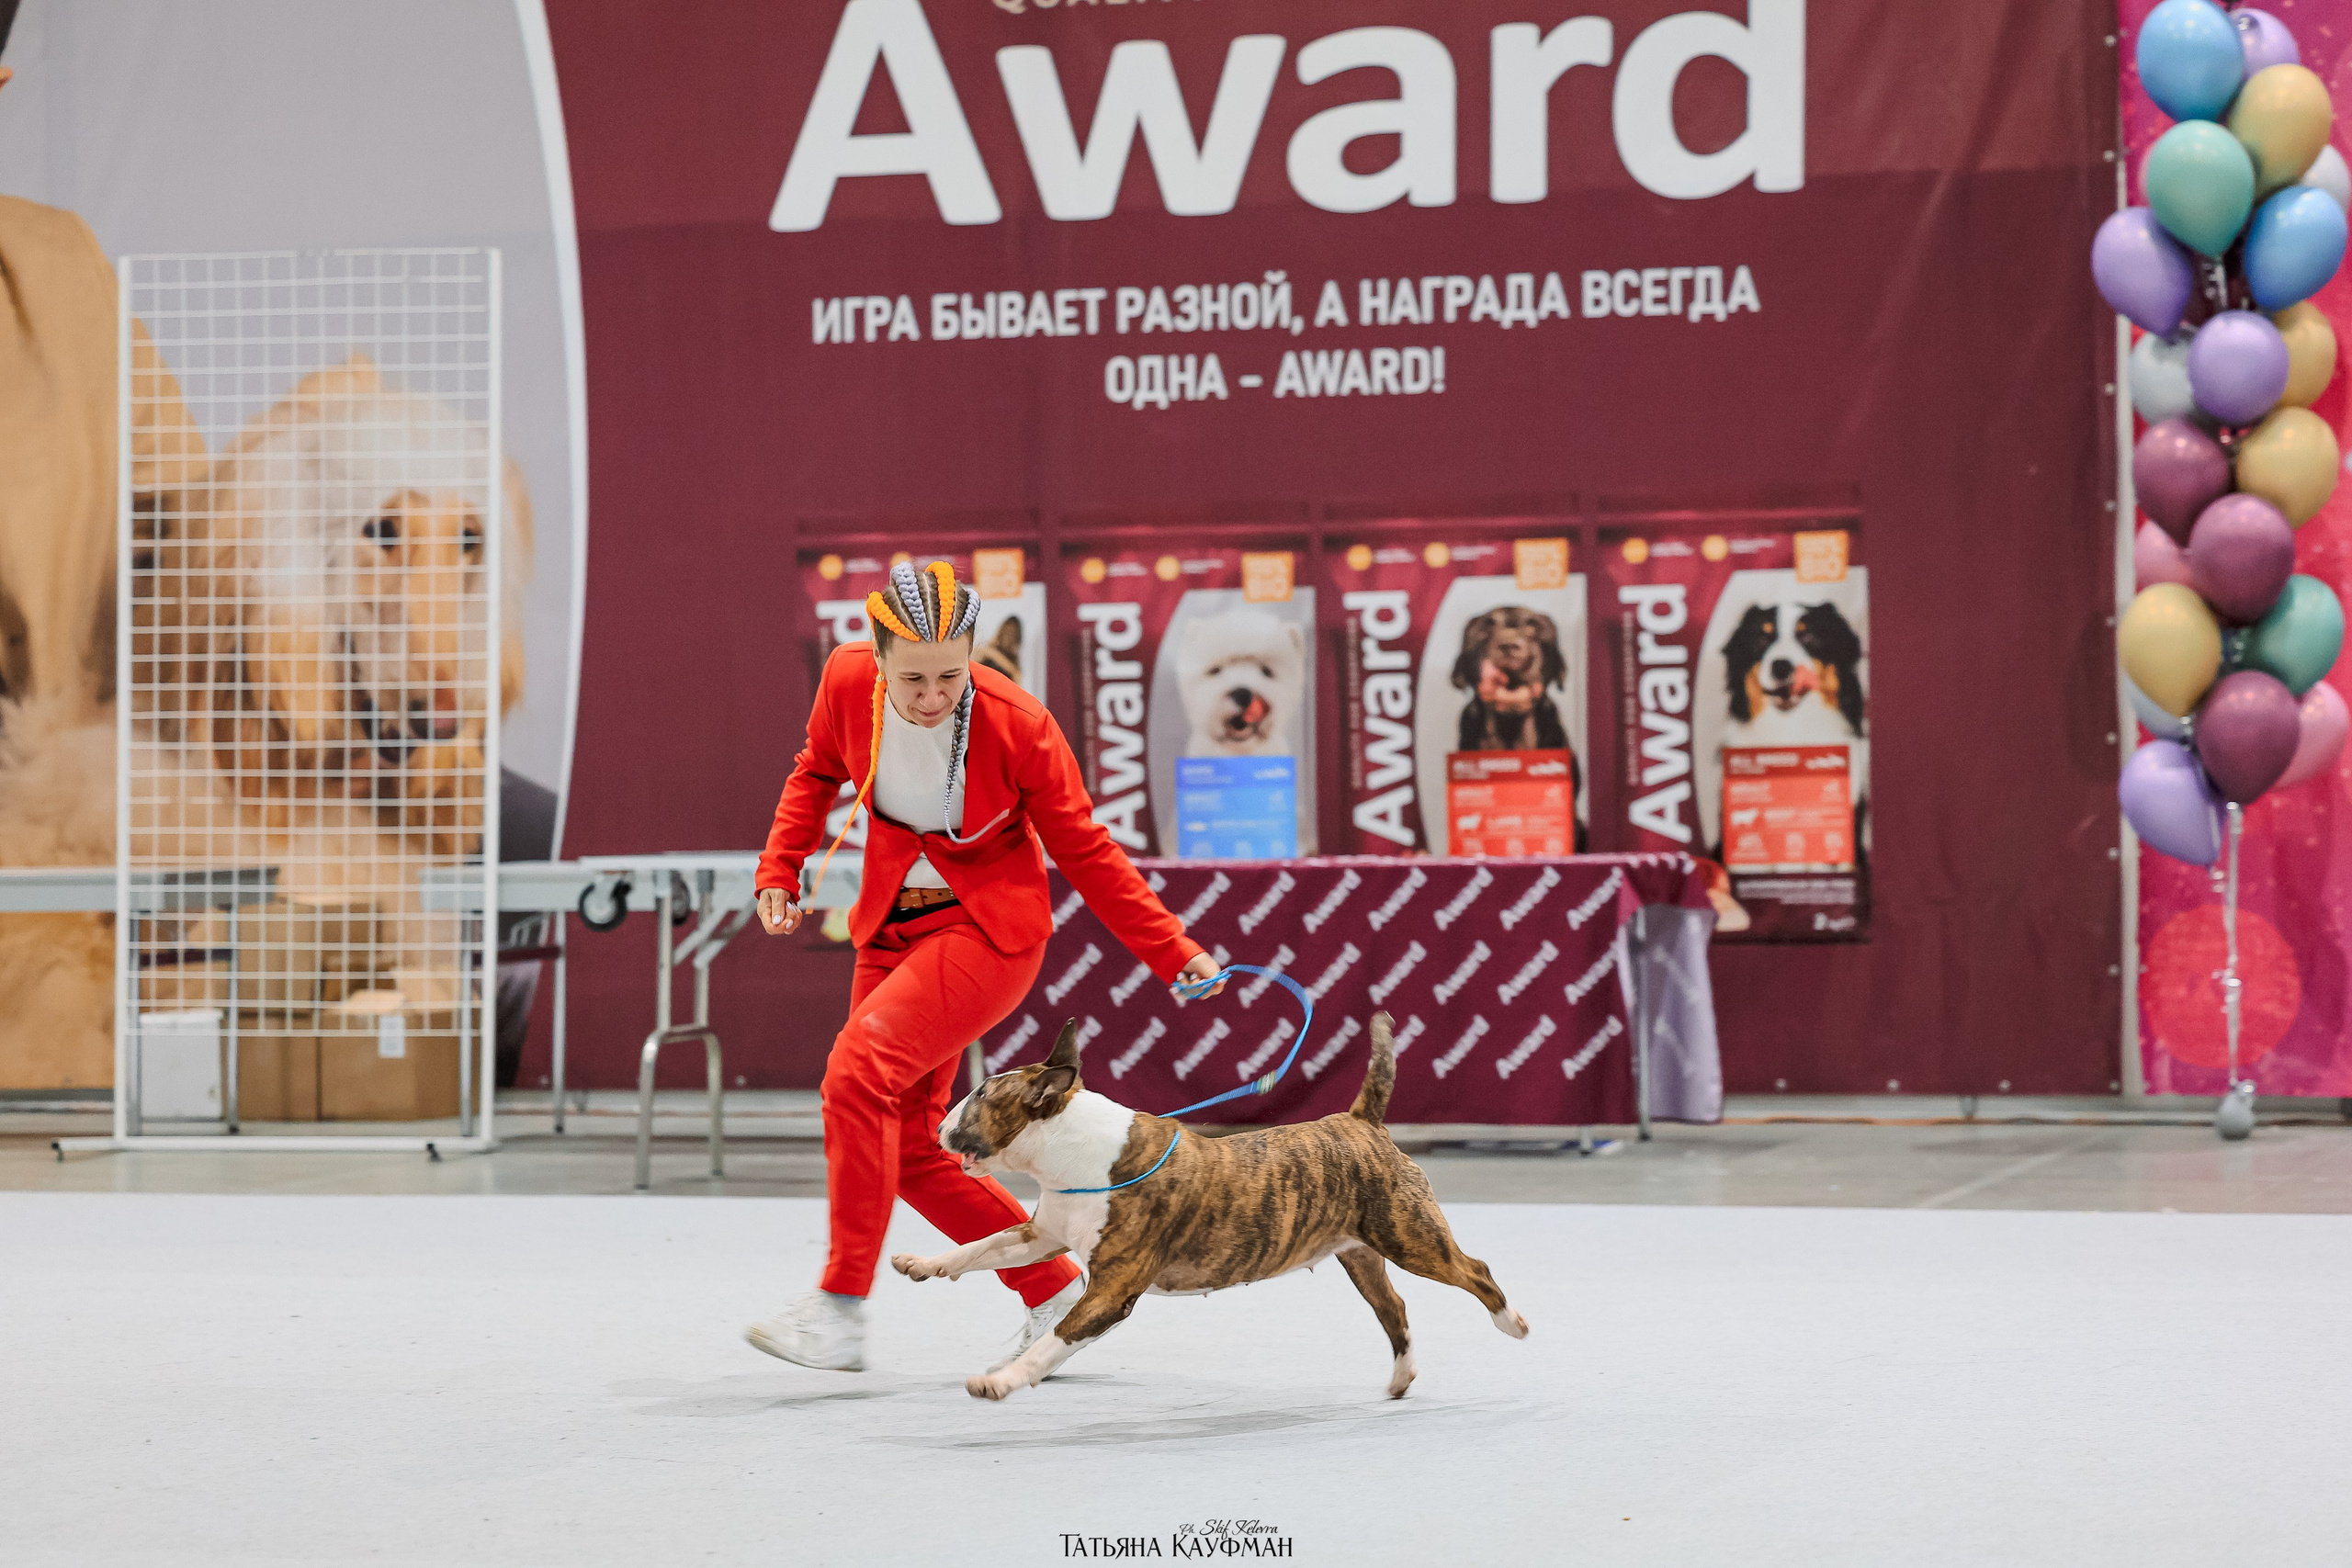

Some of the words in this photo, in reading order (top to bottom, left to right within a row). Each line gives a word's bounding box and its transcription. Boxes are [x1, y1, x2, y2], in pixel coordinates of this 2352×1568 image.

[769, 0, 1807, 232] Award
[811, 296, 921, 345] ИГРА
[931, 287, 1108, 342] БЫВАЕТ
[1114, 269, 1306, 336] РАЗНОЙ,
[1313, 280, 1350, 329] А
[1359, 273, 1571, 330] НАГРАДА
[1580, 265, 1761, 323] ВСЕГДА
[1104, 353, 1228, 411] ОДНА
[1273, 346, 1446, 399] AWARD!
[1076, 601, 1147, 851] Award
[1341, 589, 1416, 847] Award
[1617, 582, 1692, 844] Award
[1238, 870, 1296, 935] Award
[1303, 868, 1362, 934] Award
[1368, 866, 1428, 931] Award
[1433, 866, 1494, 931] Award
[1499, 865, 1561, 931] Award
[1045, 942, 1103, 1006] Award
[1369, 940, 1427, 1005] Award
[1433, 940, 1492, 1005] Award
[1497, 939, 1560, 1005] Award
[1109, 1016, 1167, 1080] Award
[1173, 1017, 1231, 1080] Award
[1237, 1017, 1295, 1081] Award
[1301, 1015, 1362, 1080] Award
[1432, 1014, 1490, 1079] Award
[1496, 1013, 1557, 1079] Award
[1561, 1015, 1623, 1079] Award
